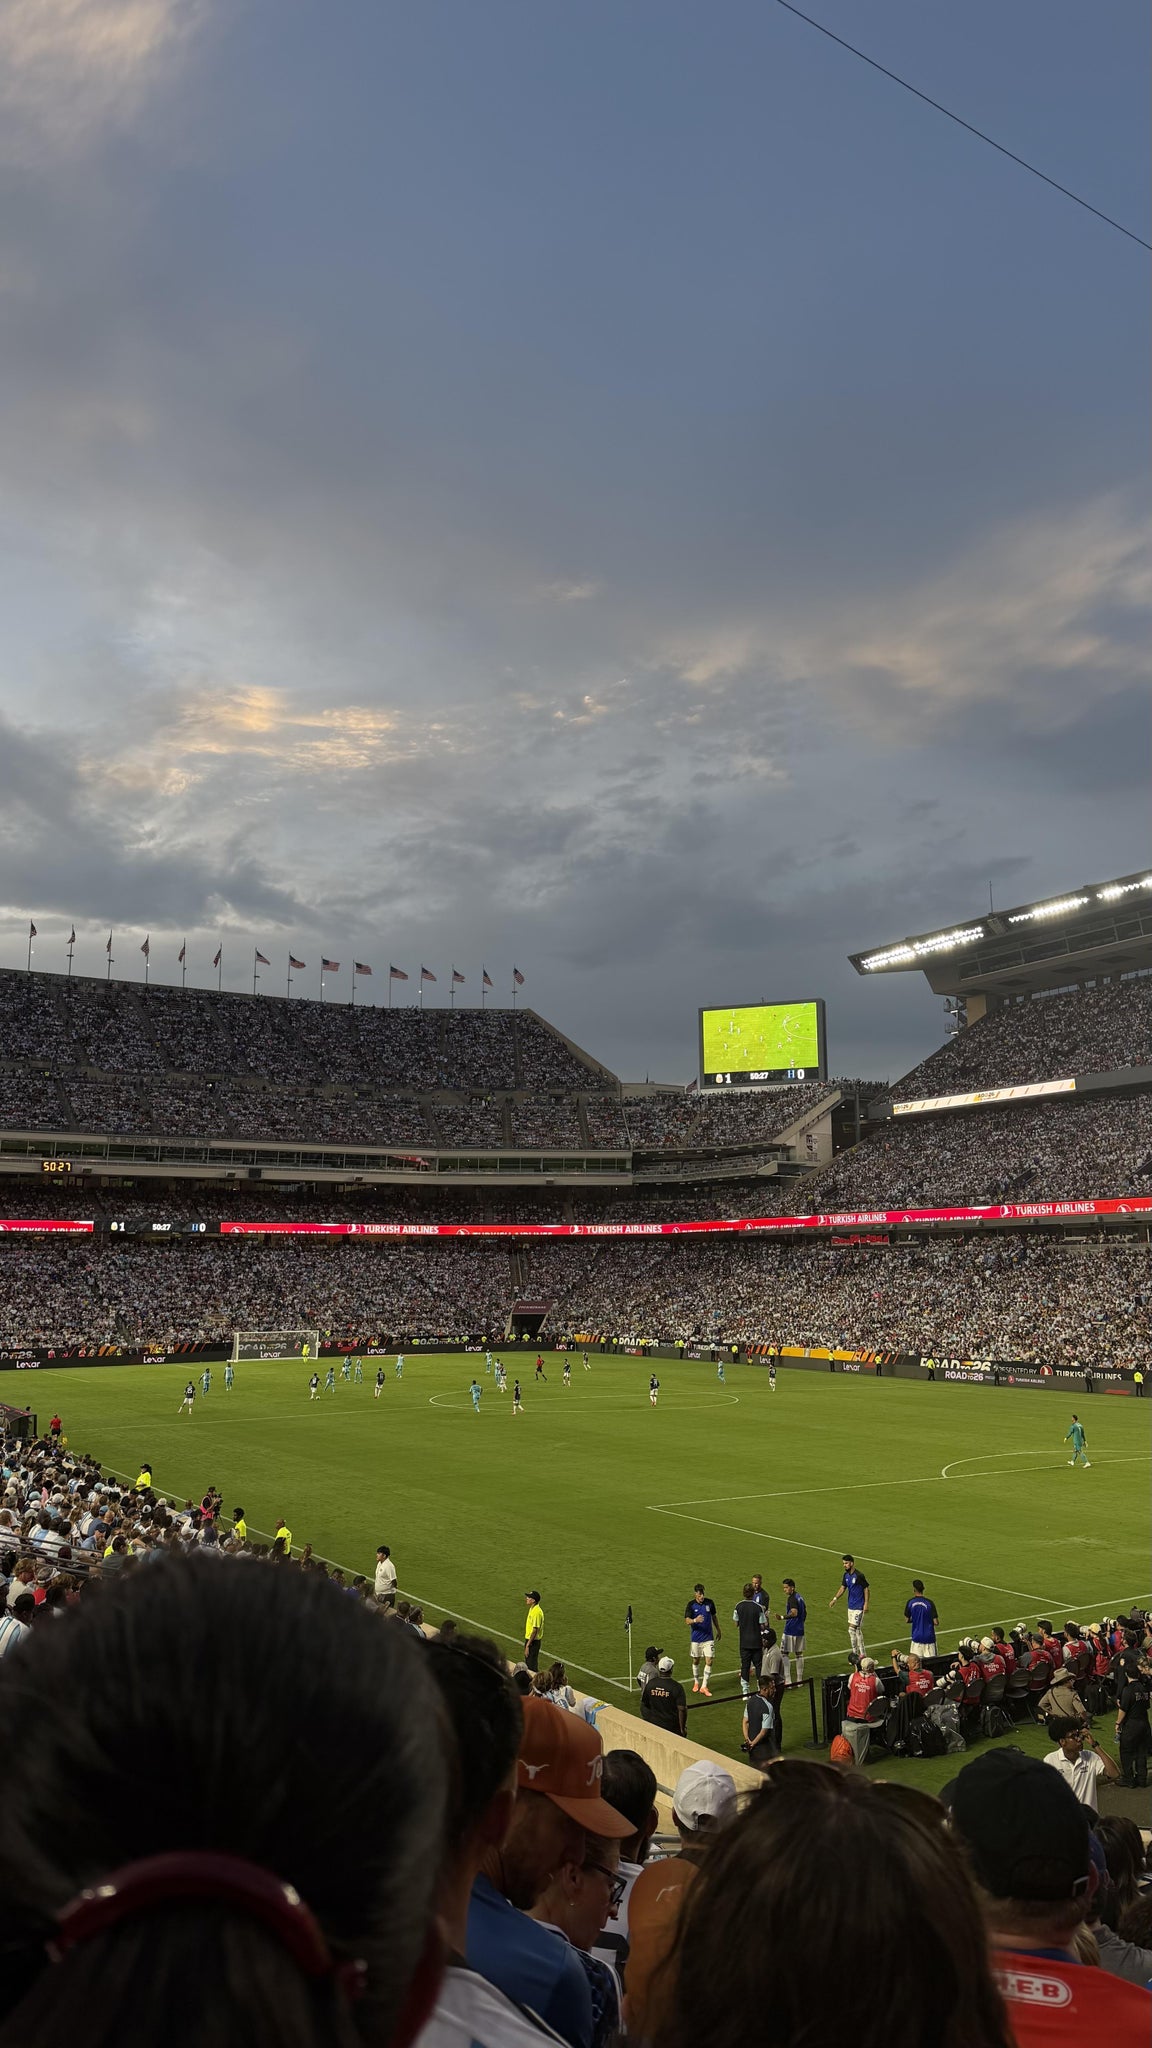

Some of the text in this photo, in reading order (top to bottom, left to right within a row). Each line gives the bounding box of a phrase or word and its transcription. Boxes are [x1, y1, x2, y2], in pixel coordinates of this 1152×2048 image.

[725, 1073, 732, 1084] 1
[750, 1072, 769, 1080] 50:27
[797, 1069, 805, 1080] 0
[1015, 1203, 1096, 1216] TURKISH AIRLINES
[829, 1214, 887, 1225] TURKISH AIRLINES
[119, 1222, 126, 1232] 1
[152, 1223, 172, 1231] 50:27
[199, 1222, 206, 1232] 0
[363, 1224, 440, 1234] TURKISH AIRLINES
[586, 1224, 663, 1234] TURKISH AIRLINES
[16, 1360, 41, 1369] Lexar
[143, 1355, 167, 1364] Lexar
[843, 1362, 861, 1371] Lexar
[945, 1371, 968, 1380] ROAD
[974, 1373, 984, 1381] 26
[651, 1689, 670, 1698] STAFF
